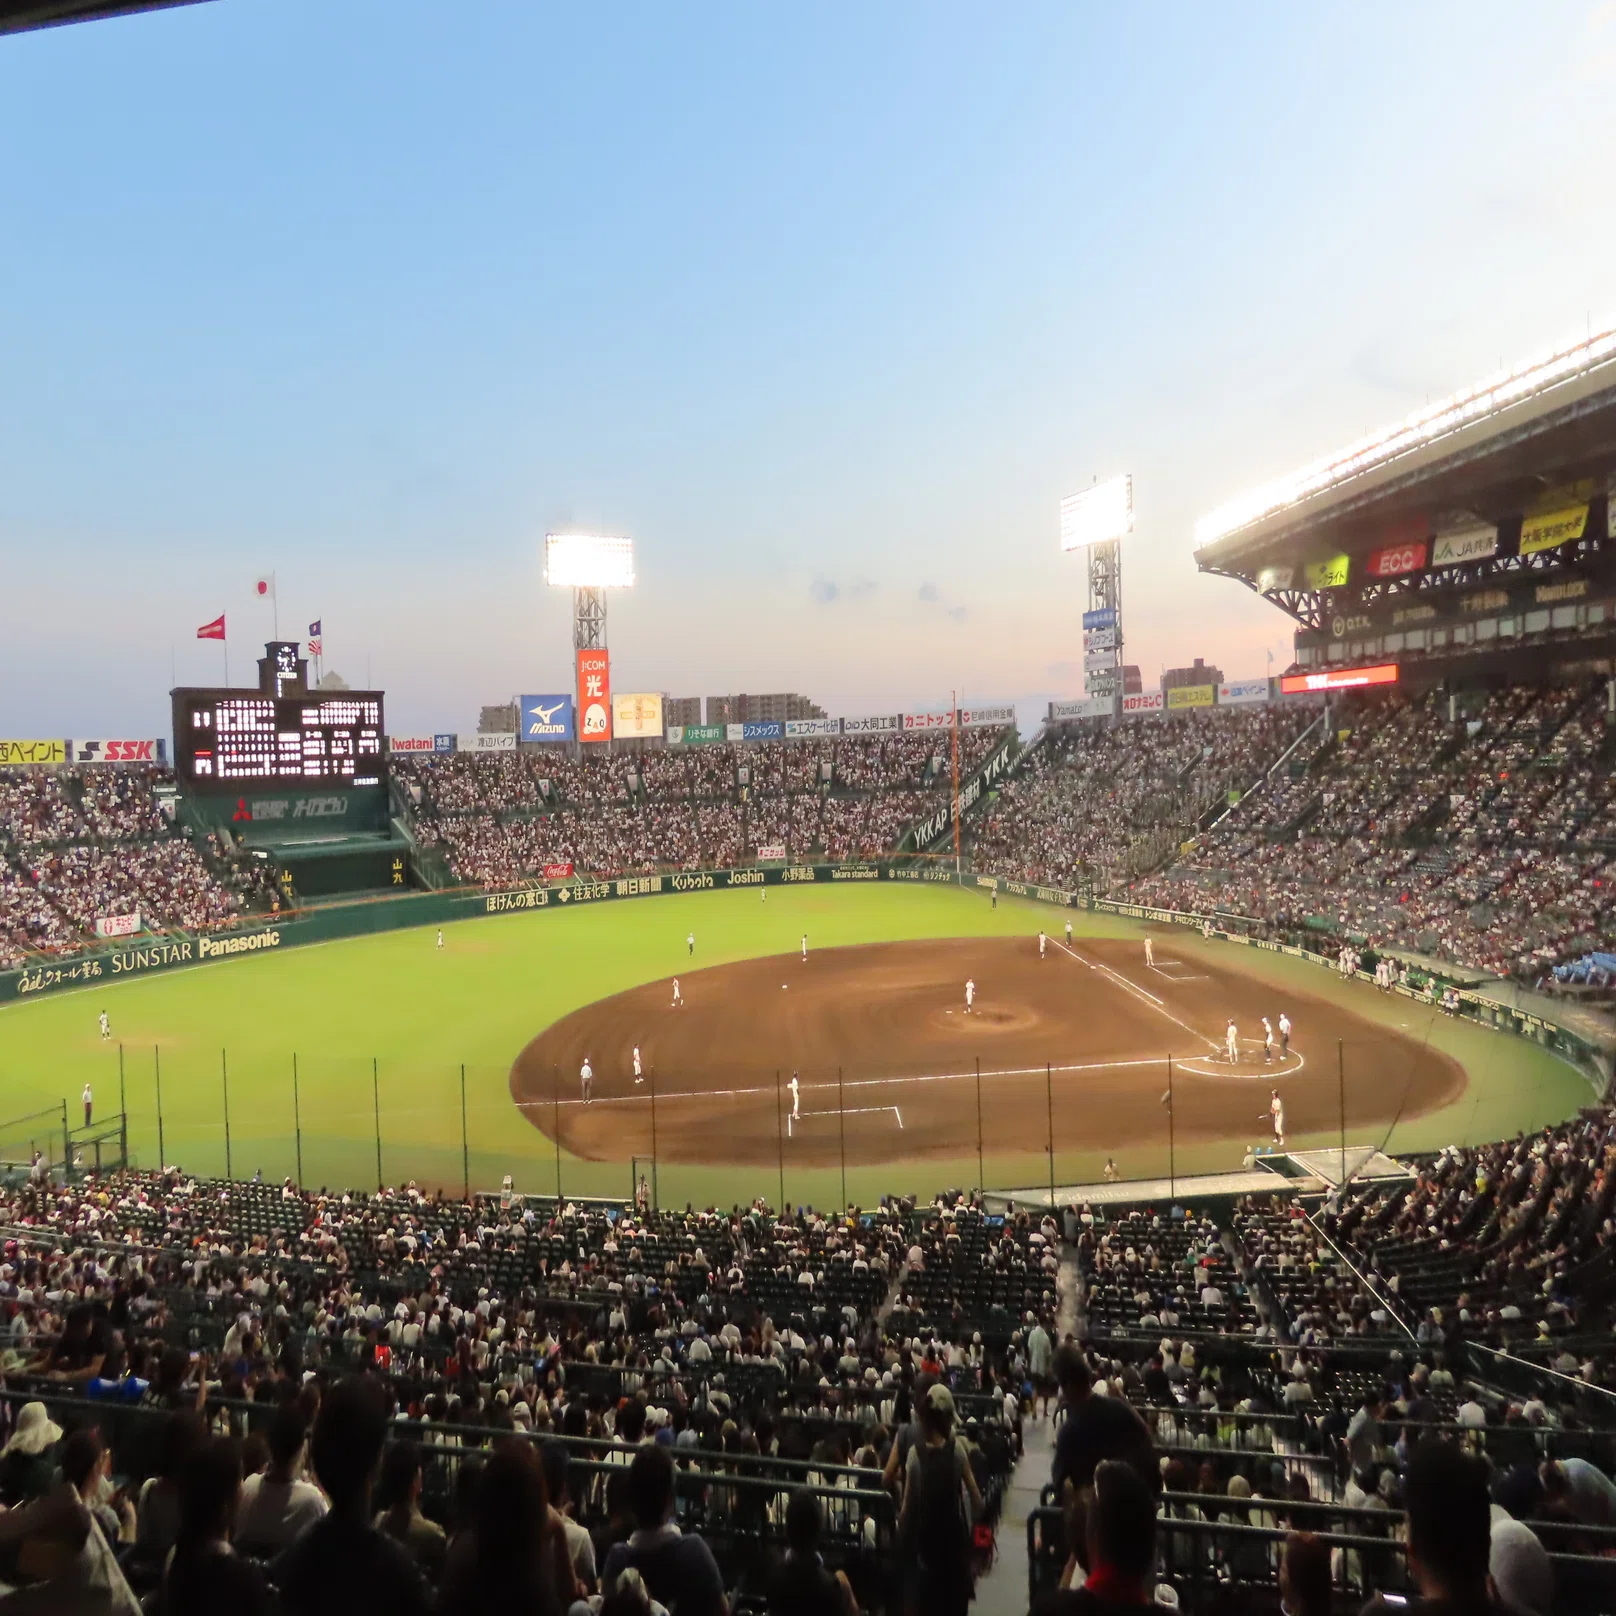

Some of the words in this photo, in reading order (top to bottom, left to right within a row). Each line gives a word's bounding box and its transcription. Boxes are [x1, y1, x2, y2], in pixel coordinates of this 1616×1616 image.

[1379, 551, 1414, 575] ECC
[581, 660, 606, 672] J:COM
[587, 674, 603, 697] 光
[744, 724, 780, 737] シスメックス
[797, 720, 838, 734] エスケー化研
[861, 716, 897, 731] 大同工業
[688, 728, 719, 739] りそな銀行
[104, 741, 153, 760] SSK
[391, 737, 433, 750] Iwatani
[392, 858, 403, 884] 山九
[727, 870, 765, 885] Joshin
[832, 869, 851, 879] Takara
[851, 869, 878, 879] standard
[616, 877, 662, 896] 朝日新聞
[672, 874, 714, 891] Kubota
[573, 885, 610, 901] 住友化学
[486, 891, 544, 912] ほけんの窓口
[199, 927, 281, 959] Panasonic
[111, 942, 193, 974] SUNSTAR
